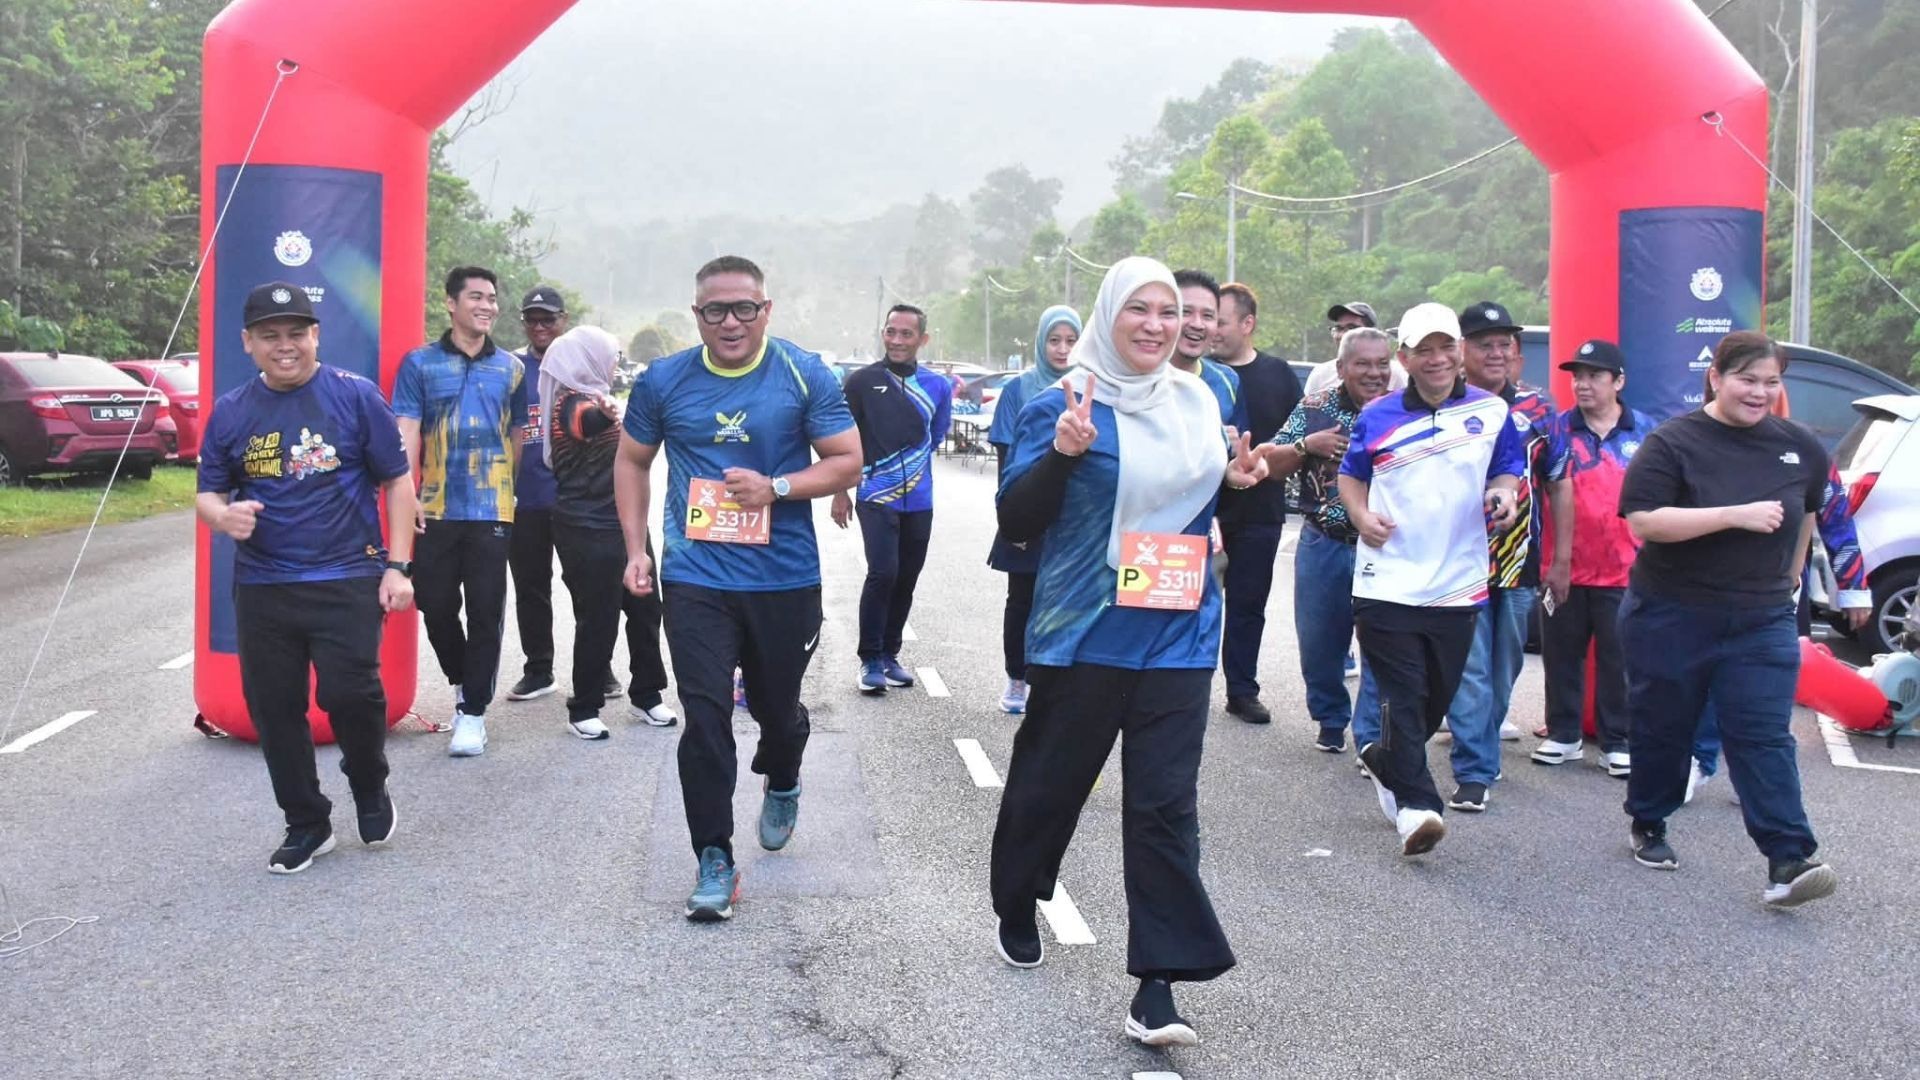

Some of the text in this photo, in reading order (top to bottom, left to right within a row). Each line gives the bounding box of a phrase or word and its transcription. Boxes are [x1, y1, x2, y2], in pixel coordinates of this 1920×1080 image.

[1695, 318, 1731, 326] Absolute
[690, 507, 703, 524] P
[716, 510, 760, 528] 5317
[1123, 568, 1140, 587] P
[1158, 569, 1200, 590] 5311
